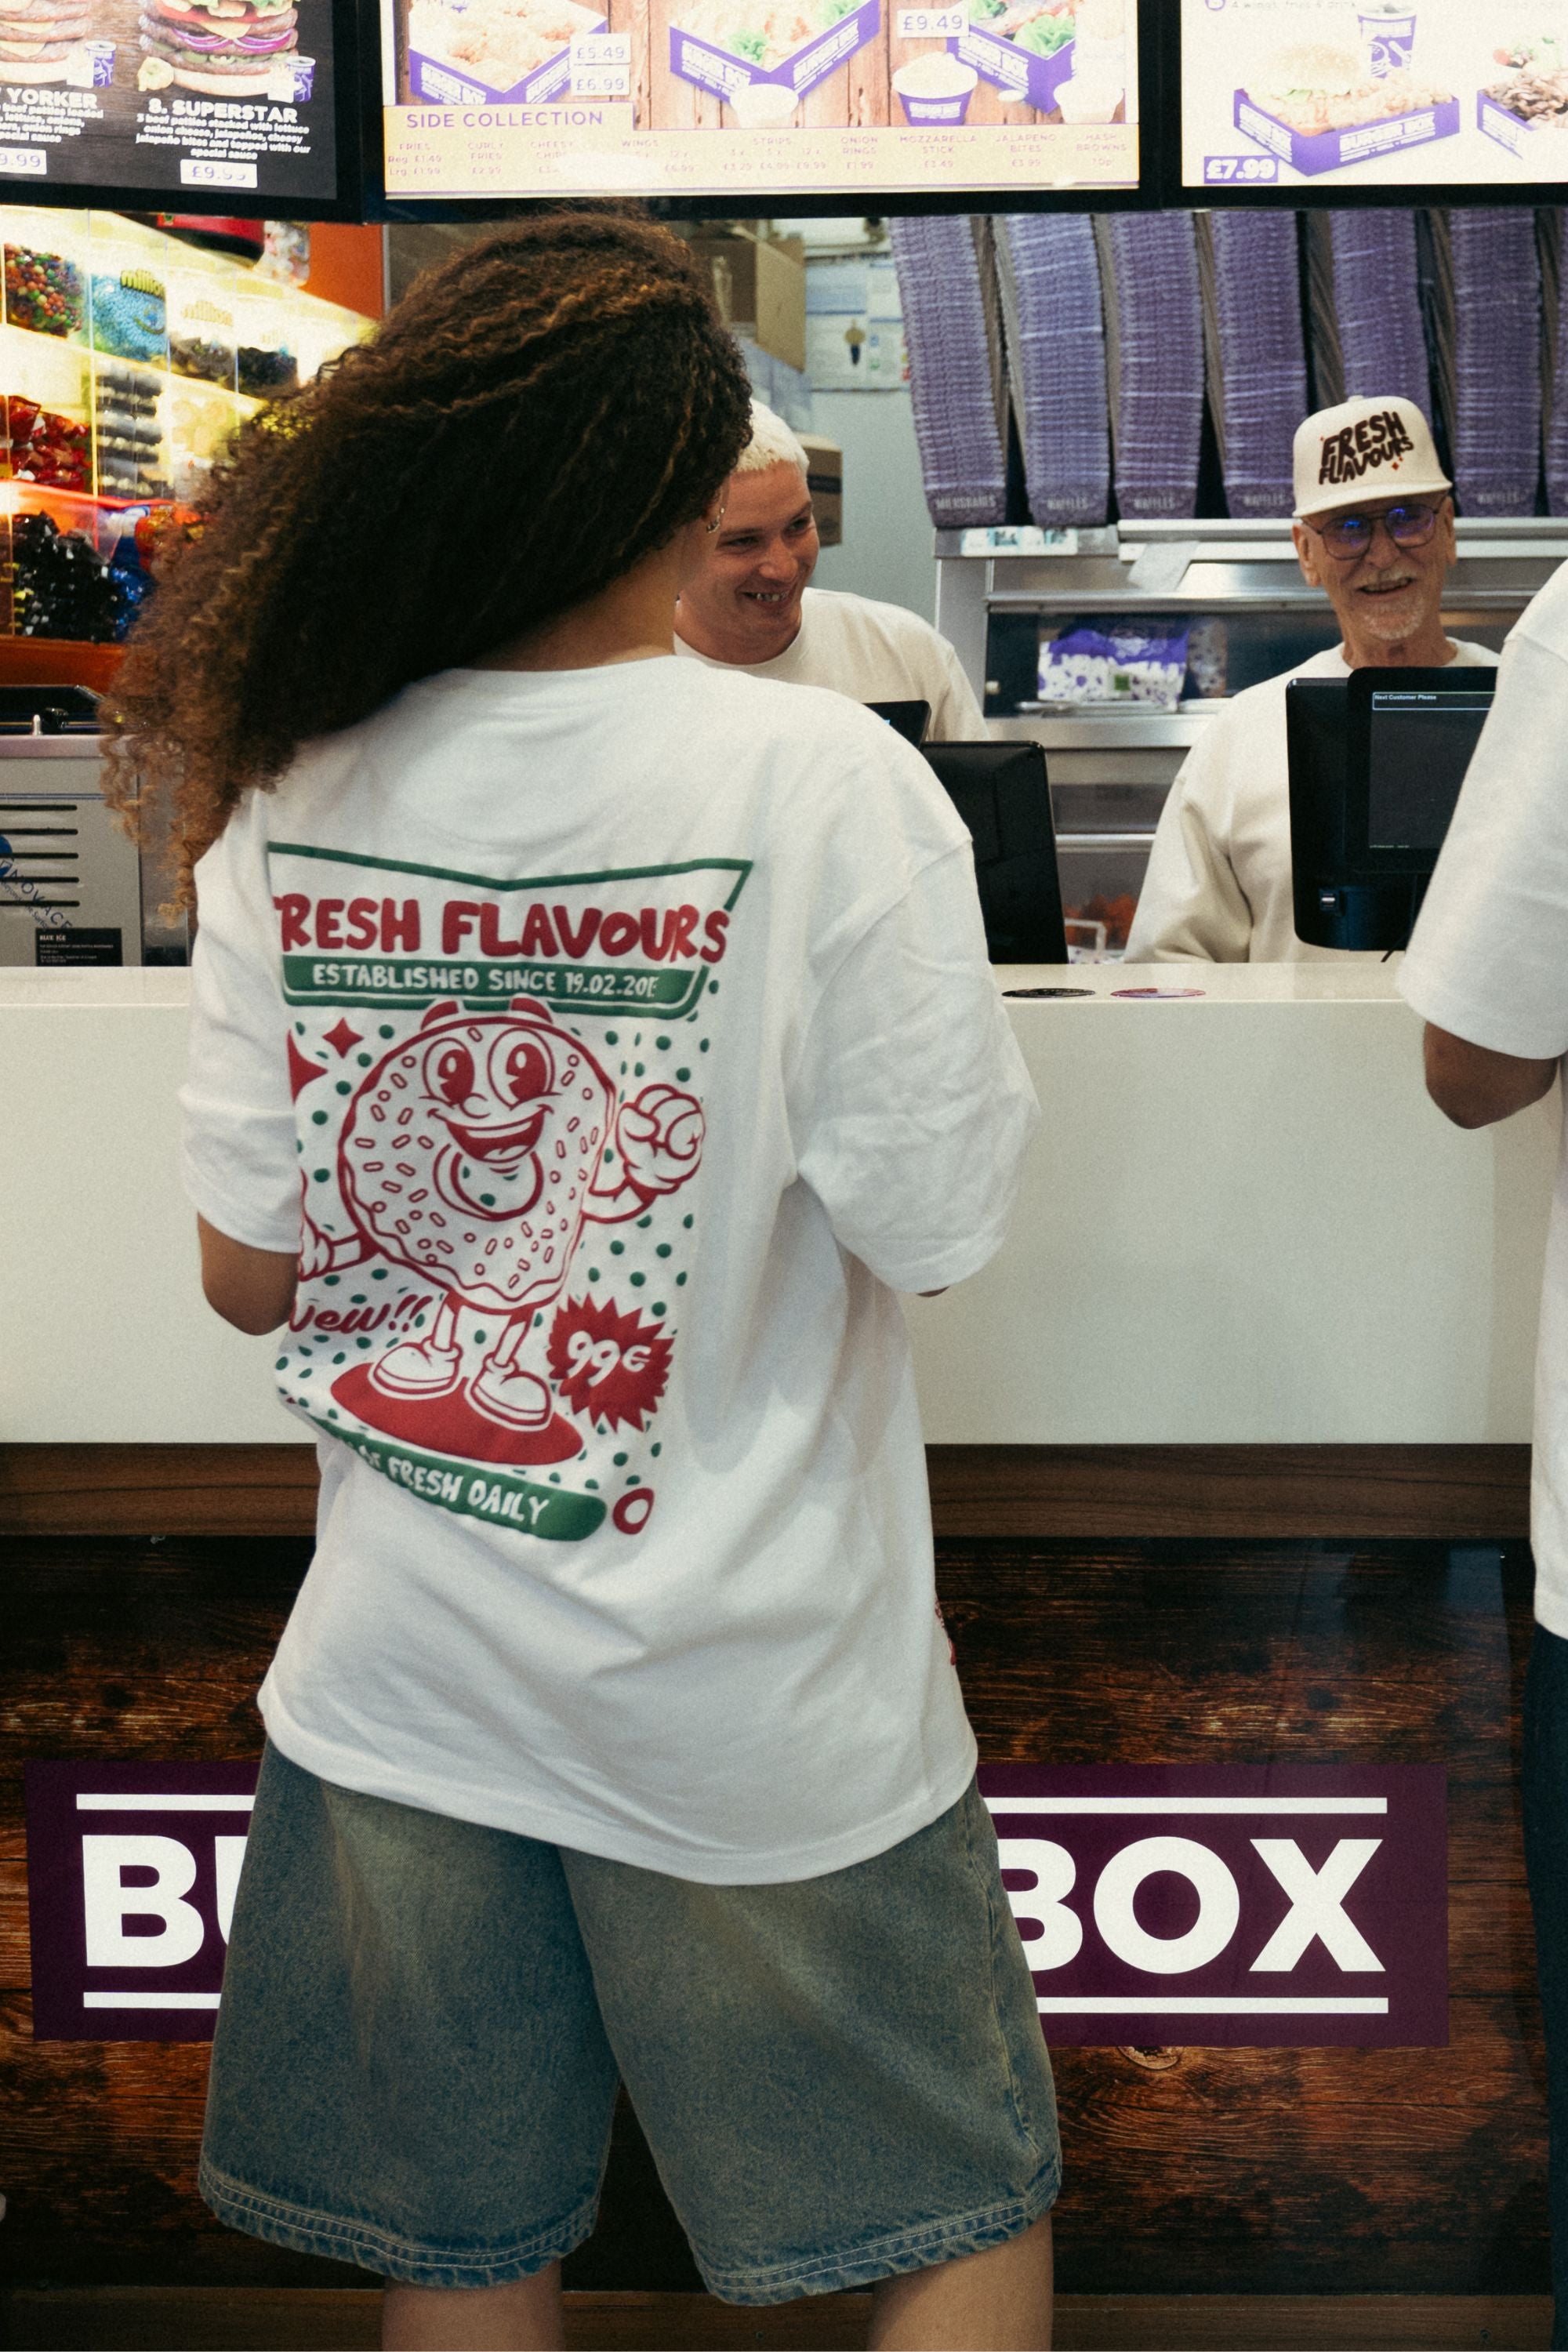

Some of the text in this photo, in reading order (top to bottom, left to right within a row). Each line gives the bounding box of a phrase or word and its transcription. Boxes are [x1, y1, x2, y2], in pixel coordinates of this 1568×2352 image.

[902, 14, 964, 31] £9.49
[576, 45, 626, 60] £5.49
[575, 77, 626, 92] £6.99
[6, 87, 98, 109] YORKER
[148, 98, 298, 124] 8. SUPERSTAR
[146, 114, 170, 125] beef
[170, 117, 207, 127] patties
[250, 122, 273, 132] with
[274, 123, 310, 134] lettuce
[406, 111, 603, 129] SIDE COLLECTION
[143, 124, 173, 134] onion
[840, 136, 880, 145] ONION
[899, 134, 978, 144] MOZZARELLA
[1085, 132, 1118, 142] HASH
[209, 139, 229, 149] and
[269, 143, 292, 153] with
[467, 141, 504, 151] CURLY
[842, 146, 877, 155] RINGS
[922, 145, 955, 154] STICK
[1009, 143, 1042, 153] BITES
[1075, 143, 1127, 152] BROWNS
[191, 148, 258, 161] special sauce
[1206, 158, 1277, 180] £7.99
[1321, 411, 1407, 477] FRESH
[1319, 435, 1414, 485] FLAVOURS
[272, 893, 731, 964] RESH FLAVOURS
[314, 964, 479, 991] ESTABLISHED
[488, 967, 556, 993] SINCE
[388, 1455, 549, 1526] FRESH DAILY
[996, 1835, 1387, 1975] BOX
